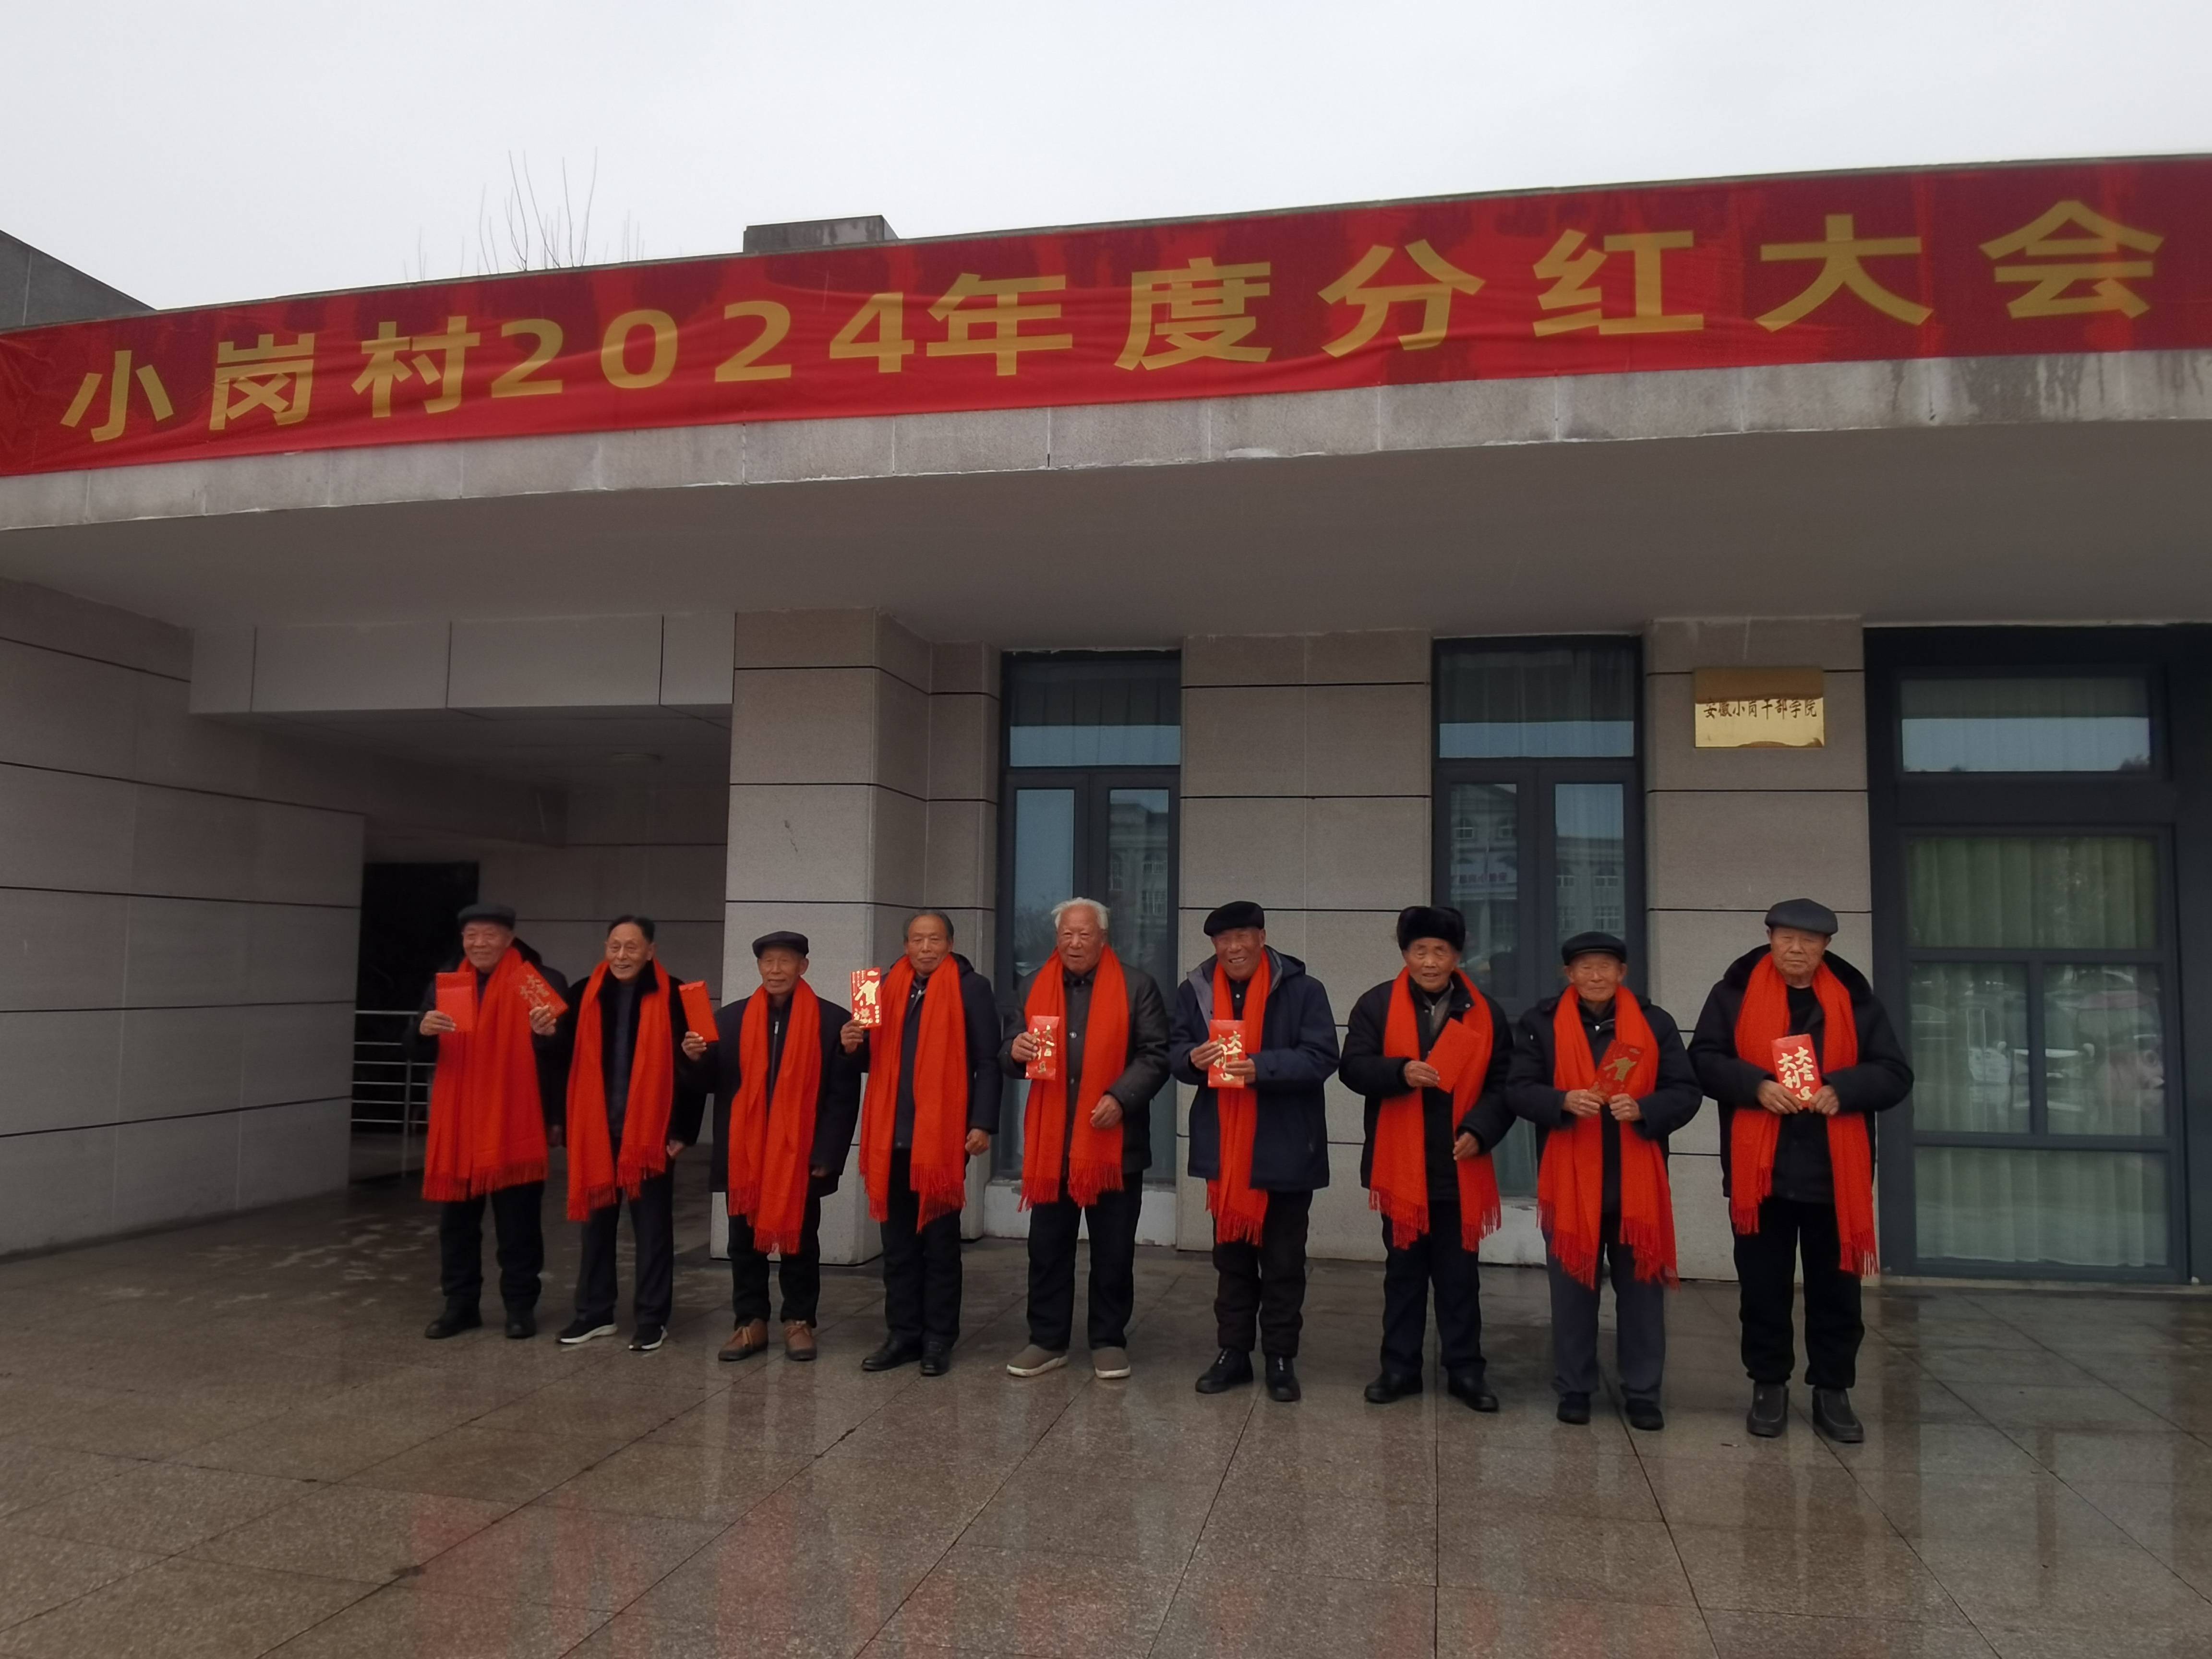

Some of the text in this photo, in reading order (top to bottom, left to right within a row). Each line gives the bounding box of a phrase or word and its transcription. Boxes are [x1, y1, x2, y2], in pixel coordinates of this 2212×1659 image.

[60, 200, 2164, 442] 小岗村2024年度分红大会
[1704, 697, 1817, 720] 安徽小岗干部学院
[1778, 1053, 1801, 1089] 大利
[1794, 1046, 1815, 1081] 大吉
